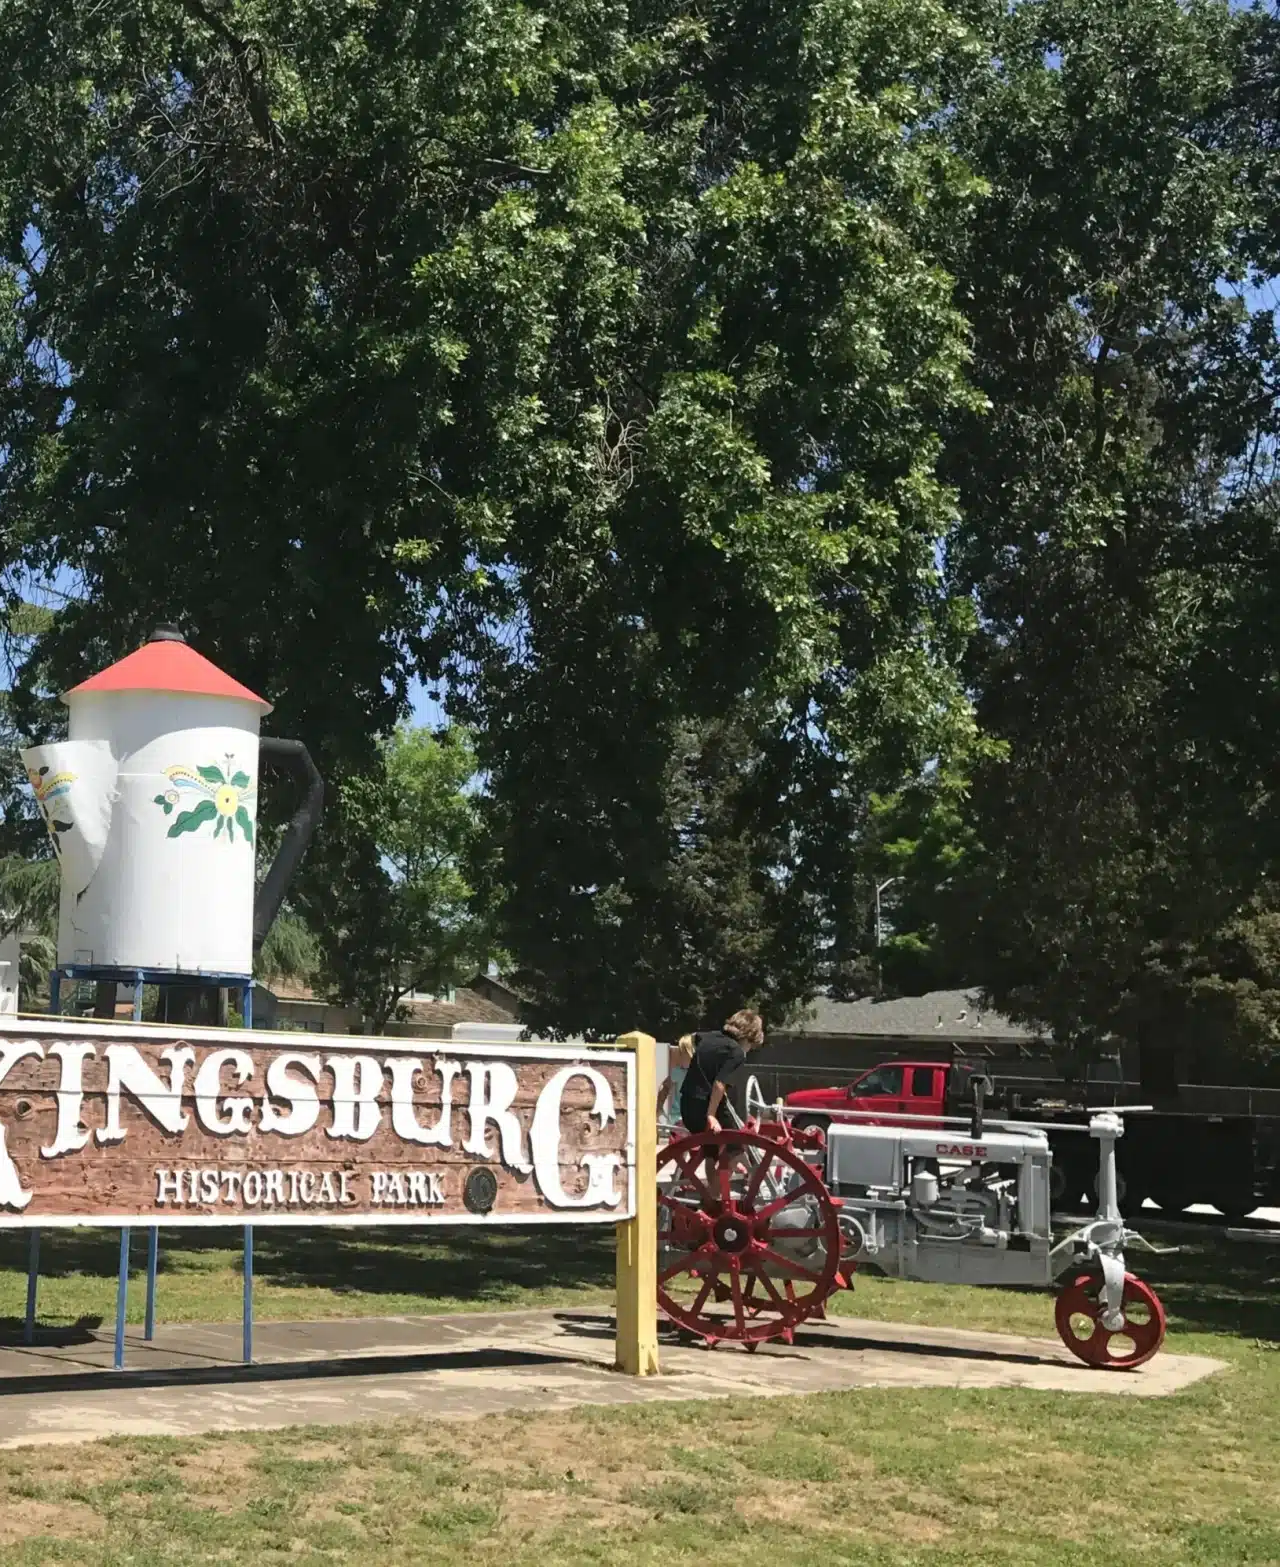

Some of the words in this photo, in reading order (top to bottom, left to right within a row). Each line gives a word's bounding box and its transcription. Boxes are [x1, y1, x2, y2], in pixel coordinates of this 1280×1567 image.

[935, 1144, 988, 1157] CASE
[155, 1168, 358, 1206] HISTORICAL
[370, 1171, 446, 1206] PARK
